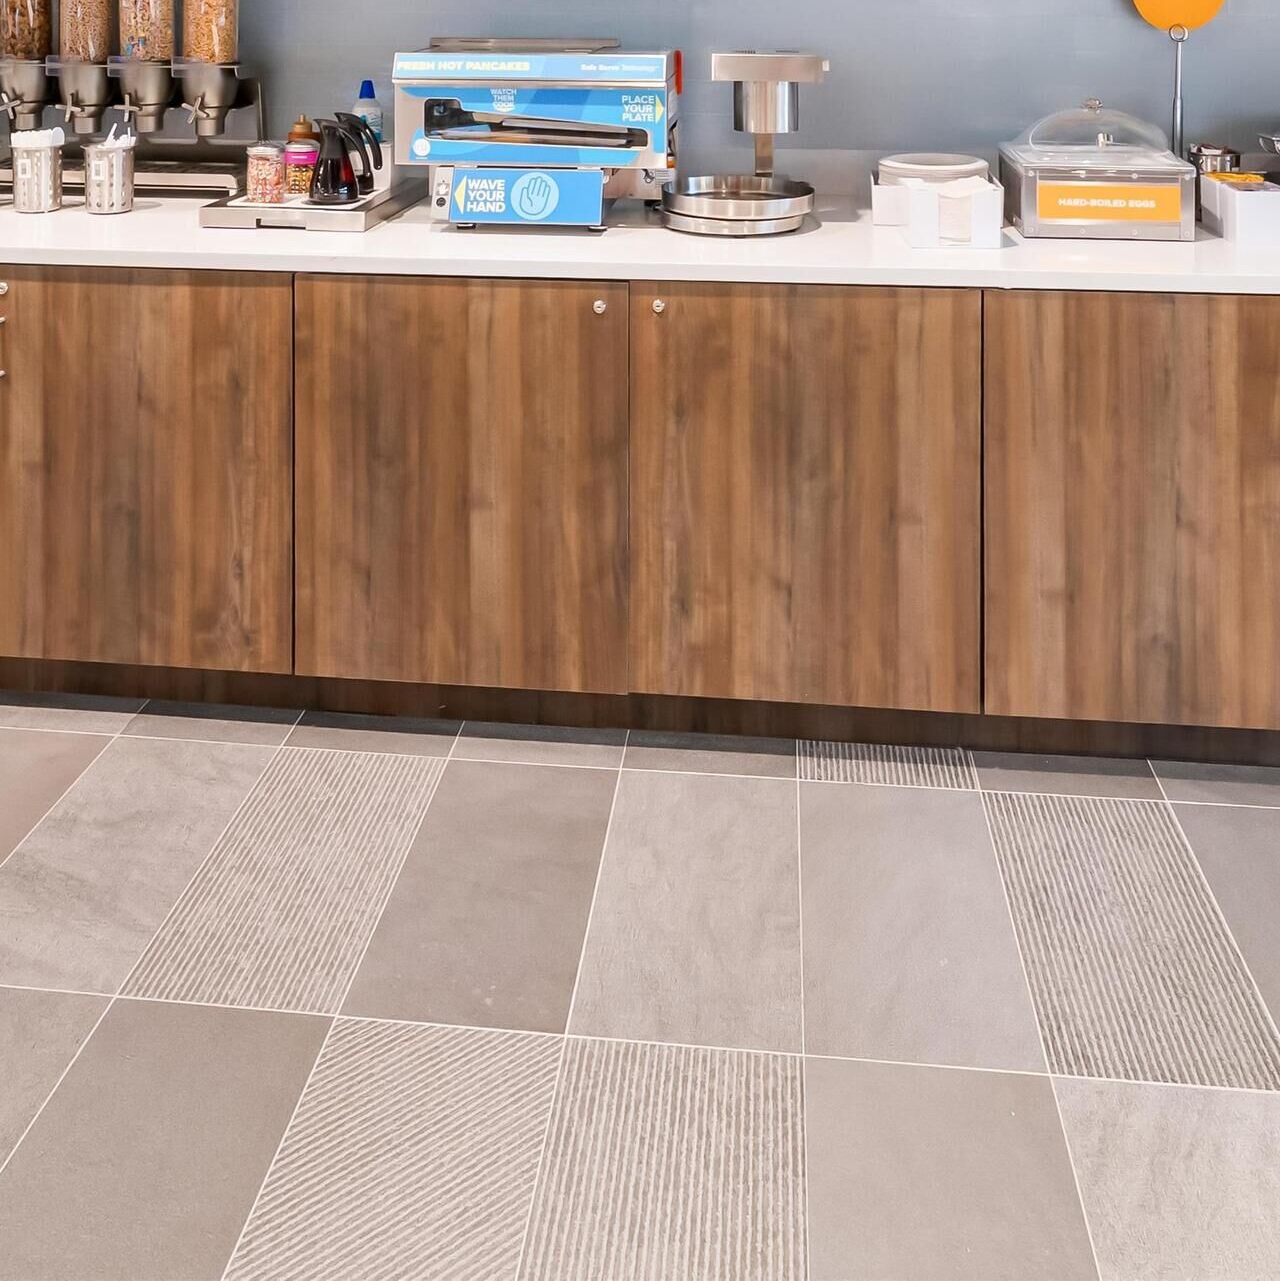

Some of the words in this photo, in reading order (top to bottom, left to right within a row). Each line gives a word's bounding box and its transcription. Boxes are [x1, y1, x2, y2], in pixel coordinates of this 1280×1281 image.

[398, 61, 434, 71] FRESH
[437, 61, 463, 71] HOT
[465, 61, 530, 72] PANCAKES
[581, 63, 597, 71] Safe
[622, 95, 655, 104] PLACE
[624, 104, 653, 113] YOUR
[622, 113, 654, 122] PLATE
[466, 179, 506, 190] WAVE
[467, 190, 505, 201] YOUR
[466, 201, 506, 212] HAND
[1058, 198, 1127, 208] HARD-BOILED
[1128, 199, 1156, 208] EGGS
